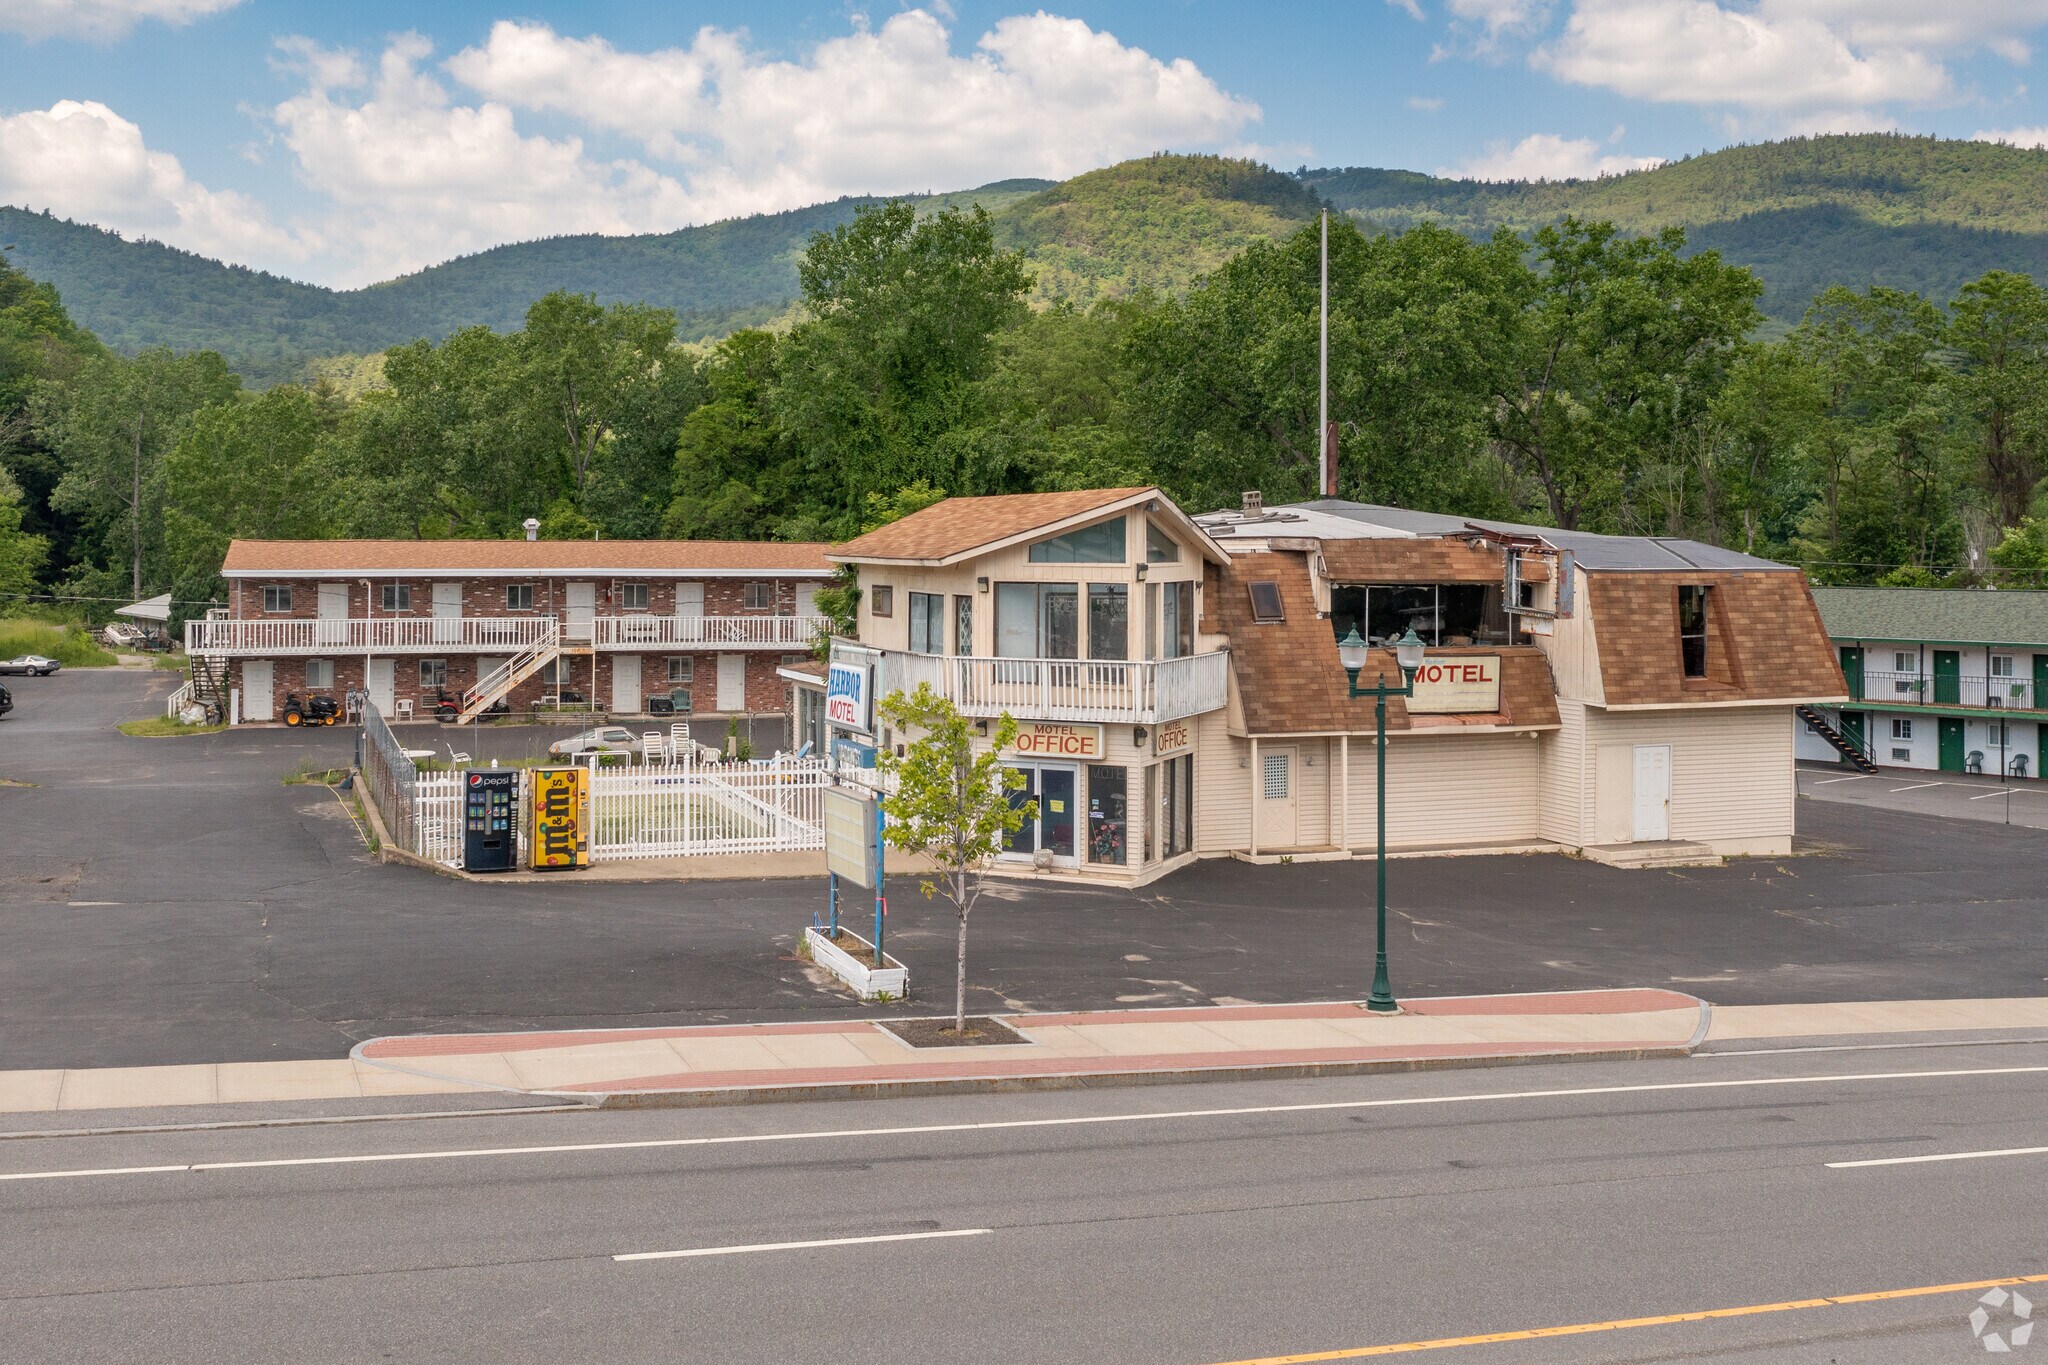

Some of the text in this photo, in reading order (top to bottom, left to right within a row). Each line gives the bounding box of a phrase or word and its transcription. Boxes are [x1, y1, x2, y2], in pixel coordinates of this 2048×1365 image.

[1414, 665, 1493, 683] MOTEL
[828, 668, 861, 705] HARBOR
[829, 699, 856, 723] MOTEL
[1034, 724, 1078, 736] MOTEL
[1164, 720, 1182, 732] MOTEL
[1016, 733, 1094, 755] OFFICE
[1158, 728, 1188, 751] OFFICE
[483, 776, 509, 786] pepsi
[1091, 766, 1126, 780] MOTE
